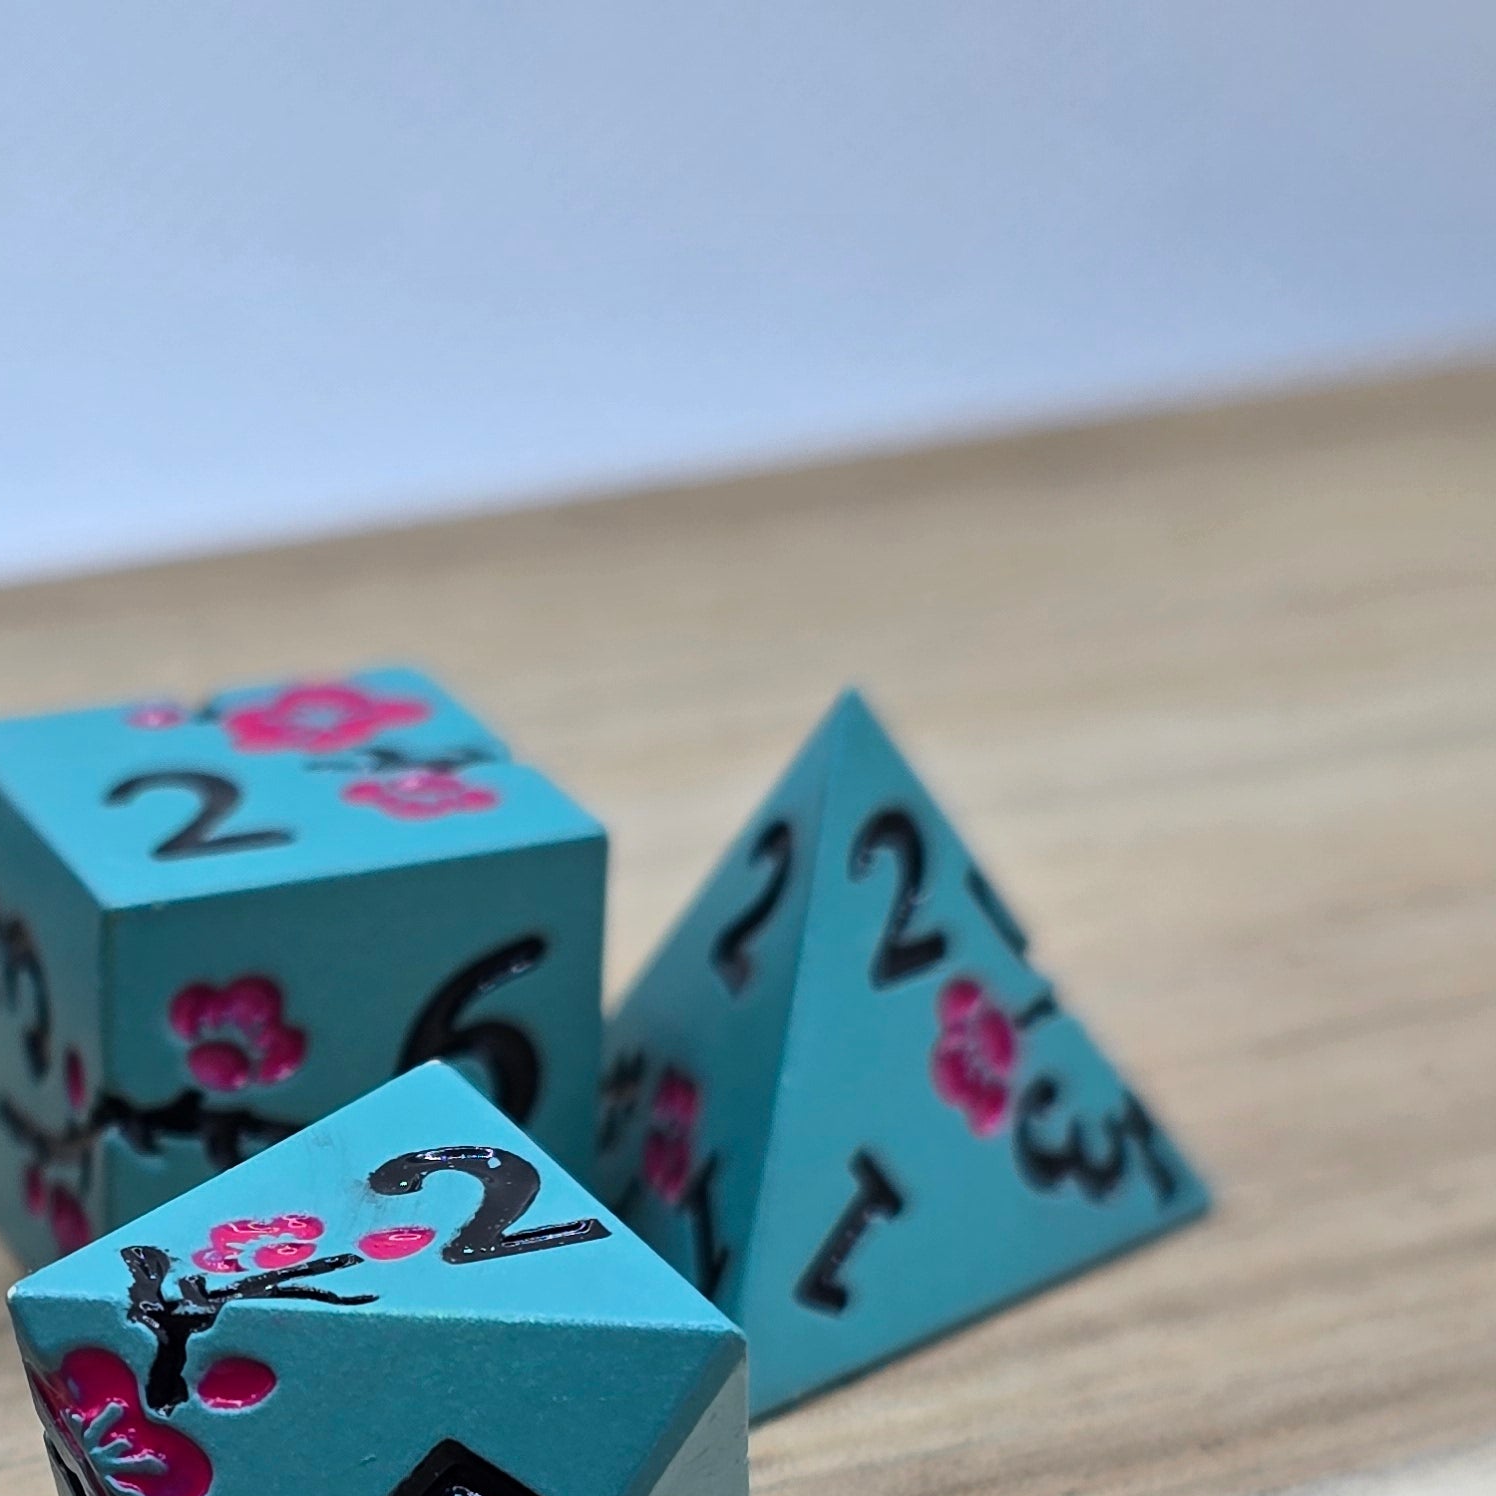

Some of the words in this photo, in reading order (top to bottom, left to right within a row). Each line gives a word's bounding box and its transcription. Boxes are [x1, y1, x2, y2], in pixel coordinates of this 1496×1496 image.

[100, 768, 297, 862] 2
[845, 806, 951, 990] 2
[392, 929, 550, 1128] 6
[366, 1145, 613, 1266] 2
[794, 1143, 905, 1319] 1
